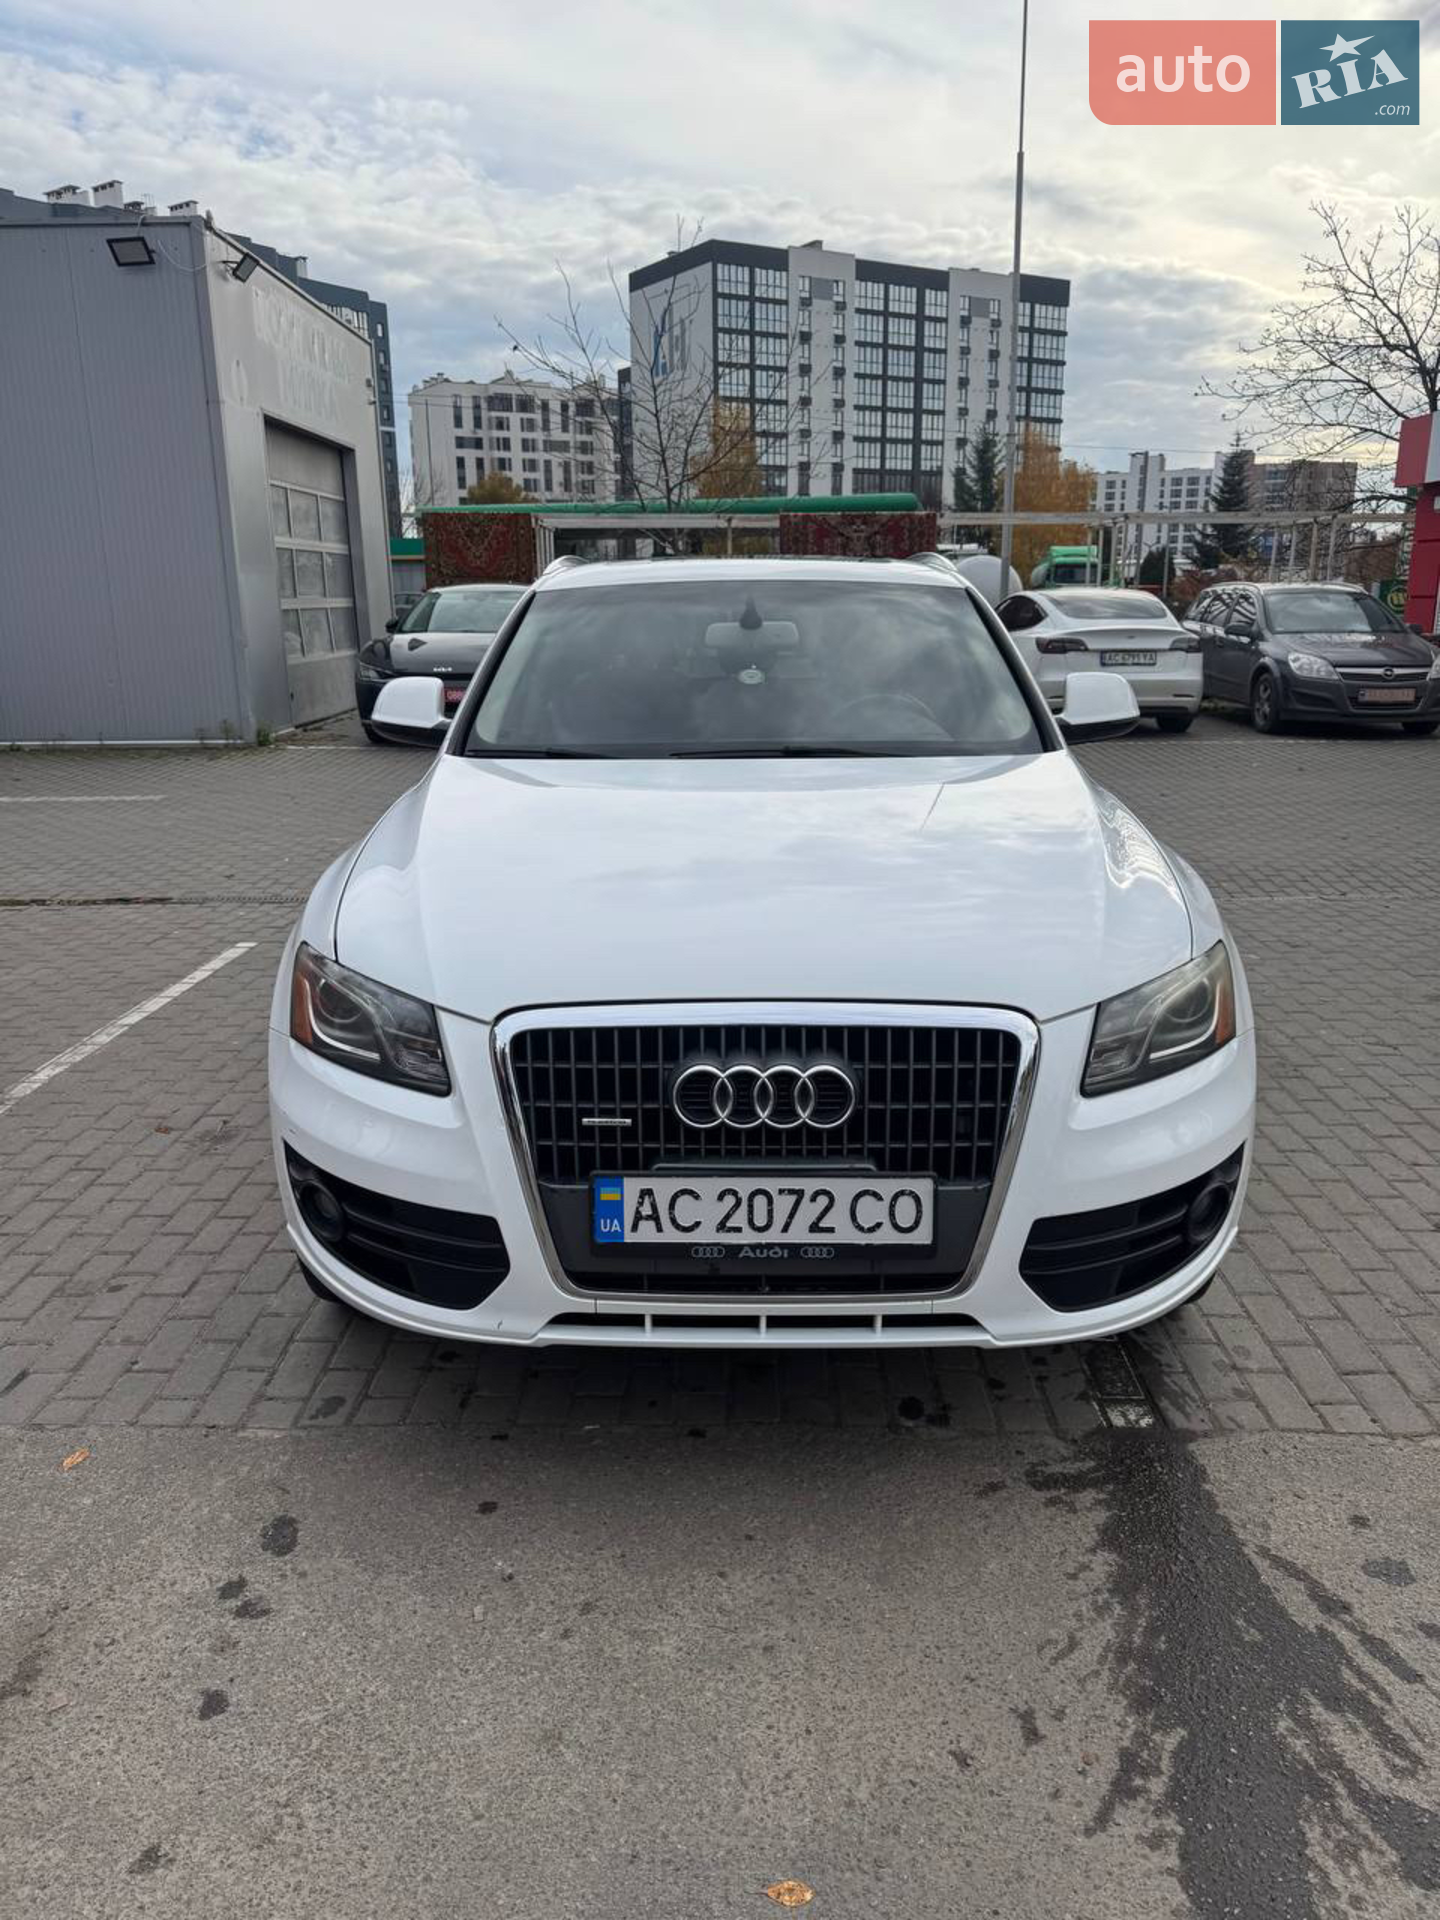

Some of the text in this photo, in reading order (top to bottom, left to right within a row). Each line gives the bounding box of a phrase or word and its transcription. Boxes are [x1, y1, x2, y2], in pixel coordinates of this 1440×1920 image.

[630, 1187, 923, 1235] AC 2072 CO
[600, 1217, 622, 1233] UA
[738, 1246, 789, 1258] Audi
